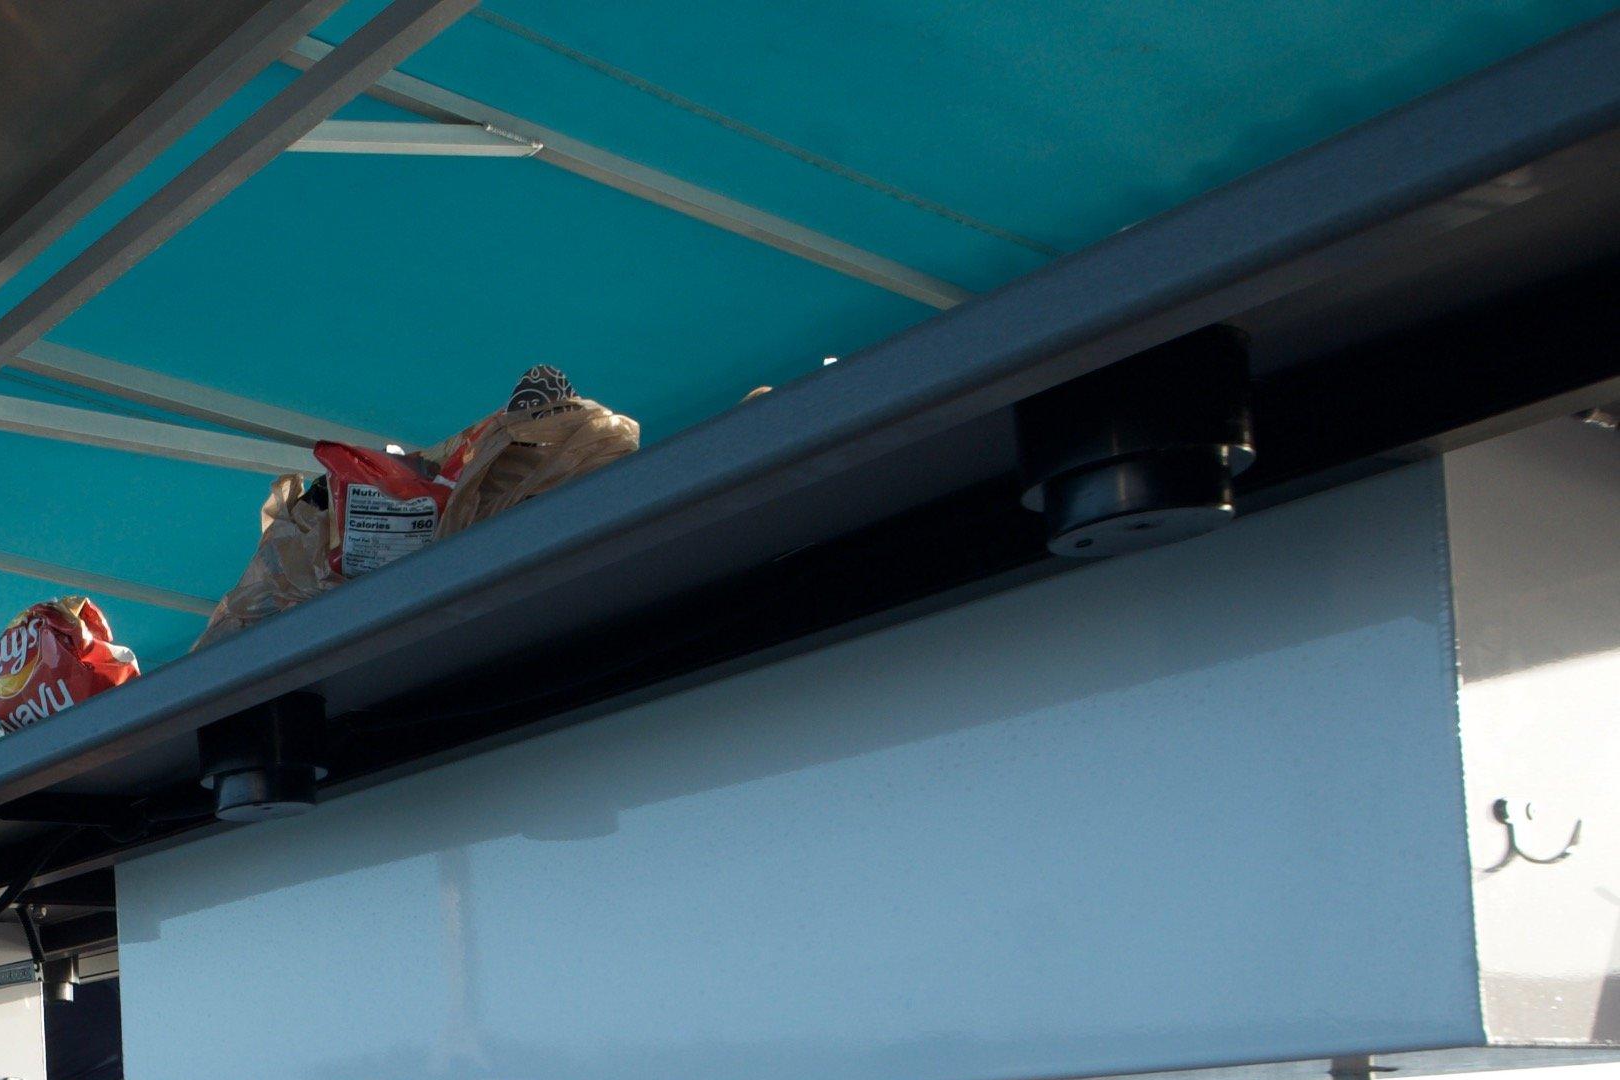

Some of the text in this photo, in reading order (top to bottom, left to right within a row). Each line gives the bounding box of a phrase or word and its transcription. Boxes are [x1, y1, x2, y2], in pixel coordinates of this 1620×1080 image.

[351, 488, 381, 497] Nutri
[349, 519, 433, 530] Calories 160
